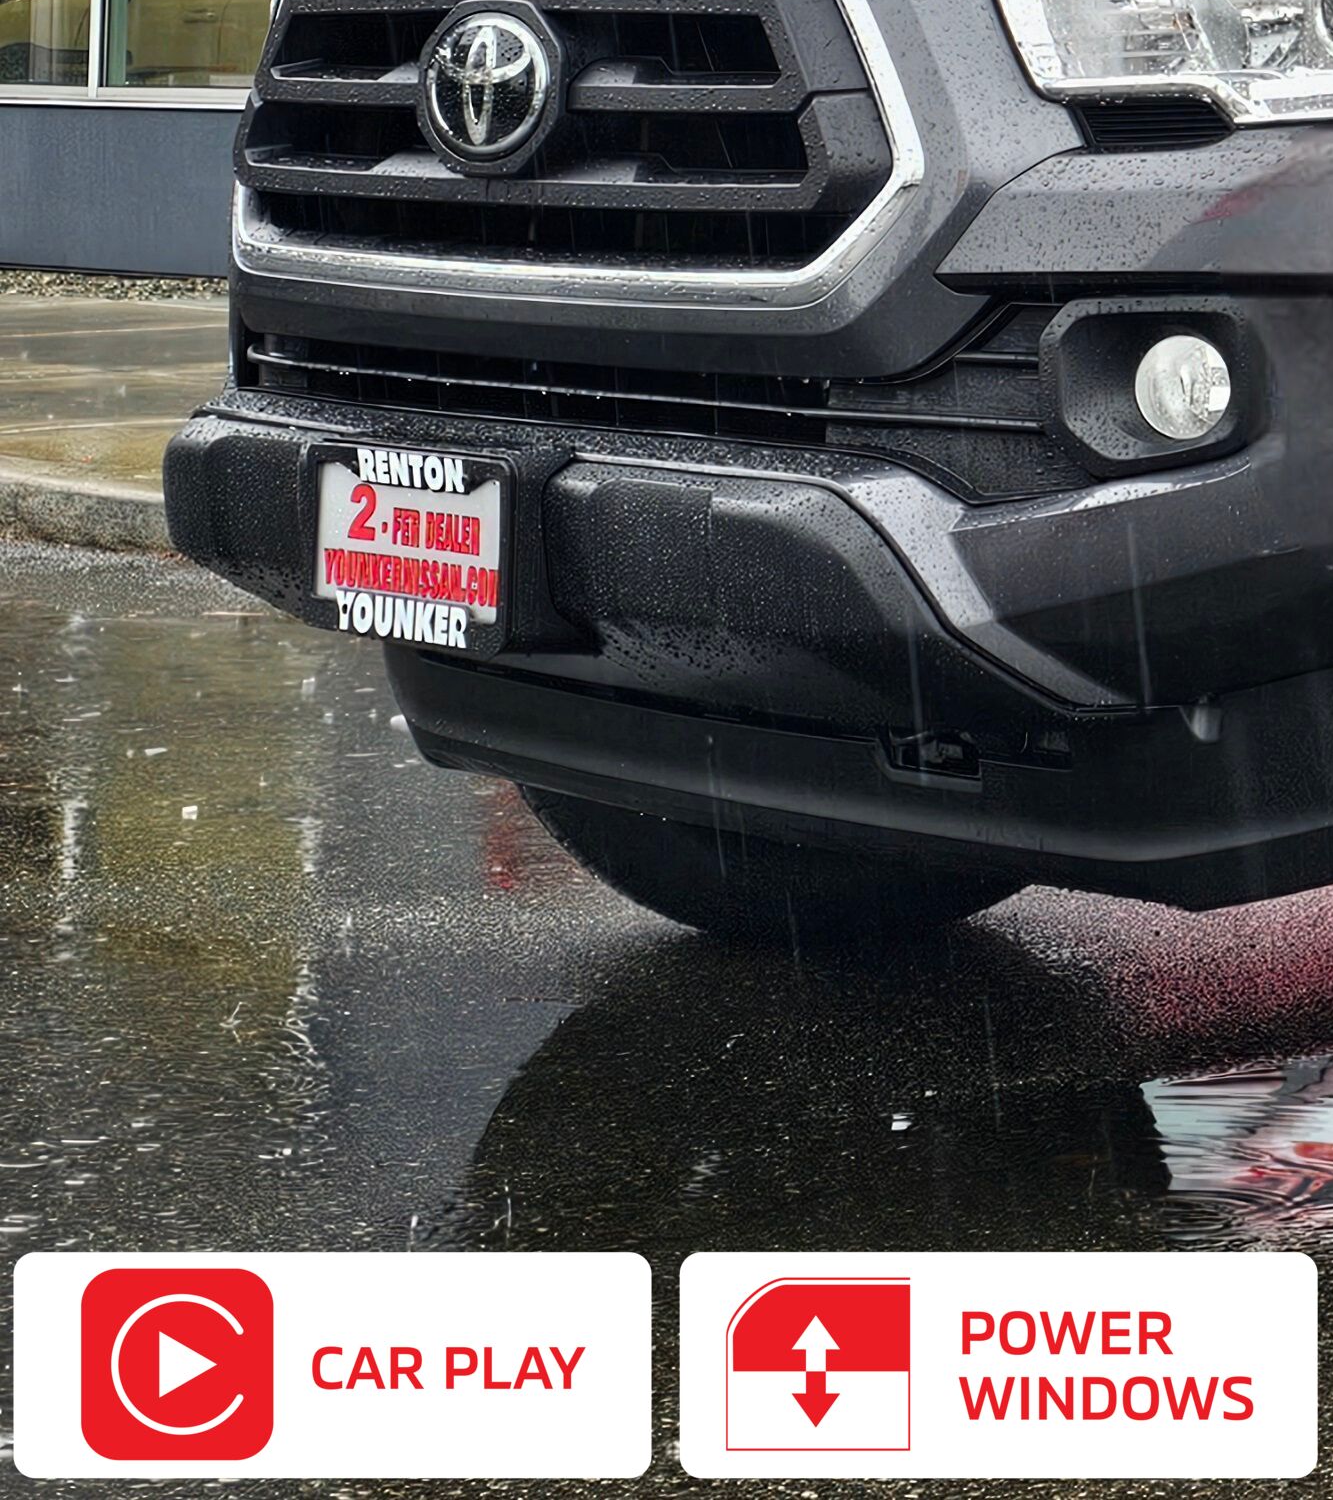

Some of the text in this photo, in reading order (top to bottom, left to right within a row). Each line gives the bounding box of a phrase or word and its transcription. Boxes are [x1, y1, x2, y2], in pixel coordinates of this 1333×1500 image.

[357, 448, 465, 494] RENTON
[391, 507, 421, 549] PER
[425, 511, 481, 557] DEALER
[335, 591, 467, 649] YOUNKER
